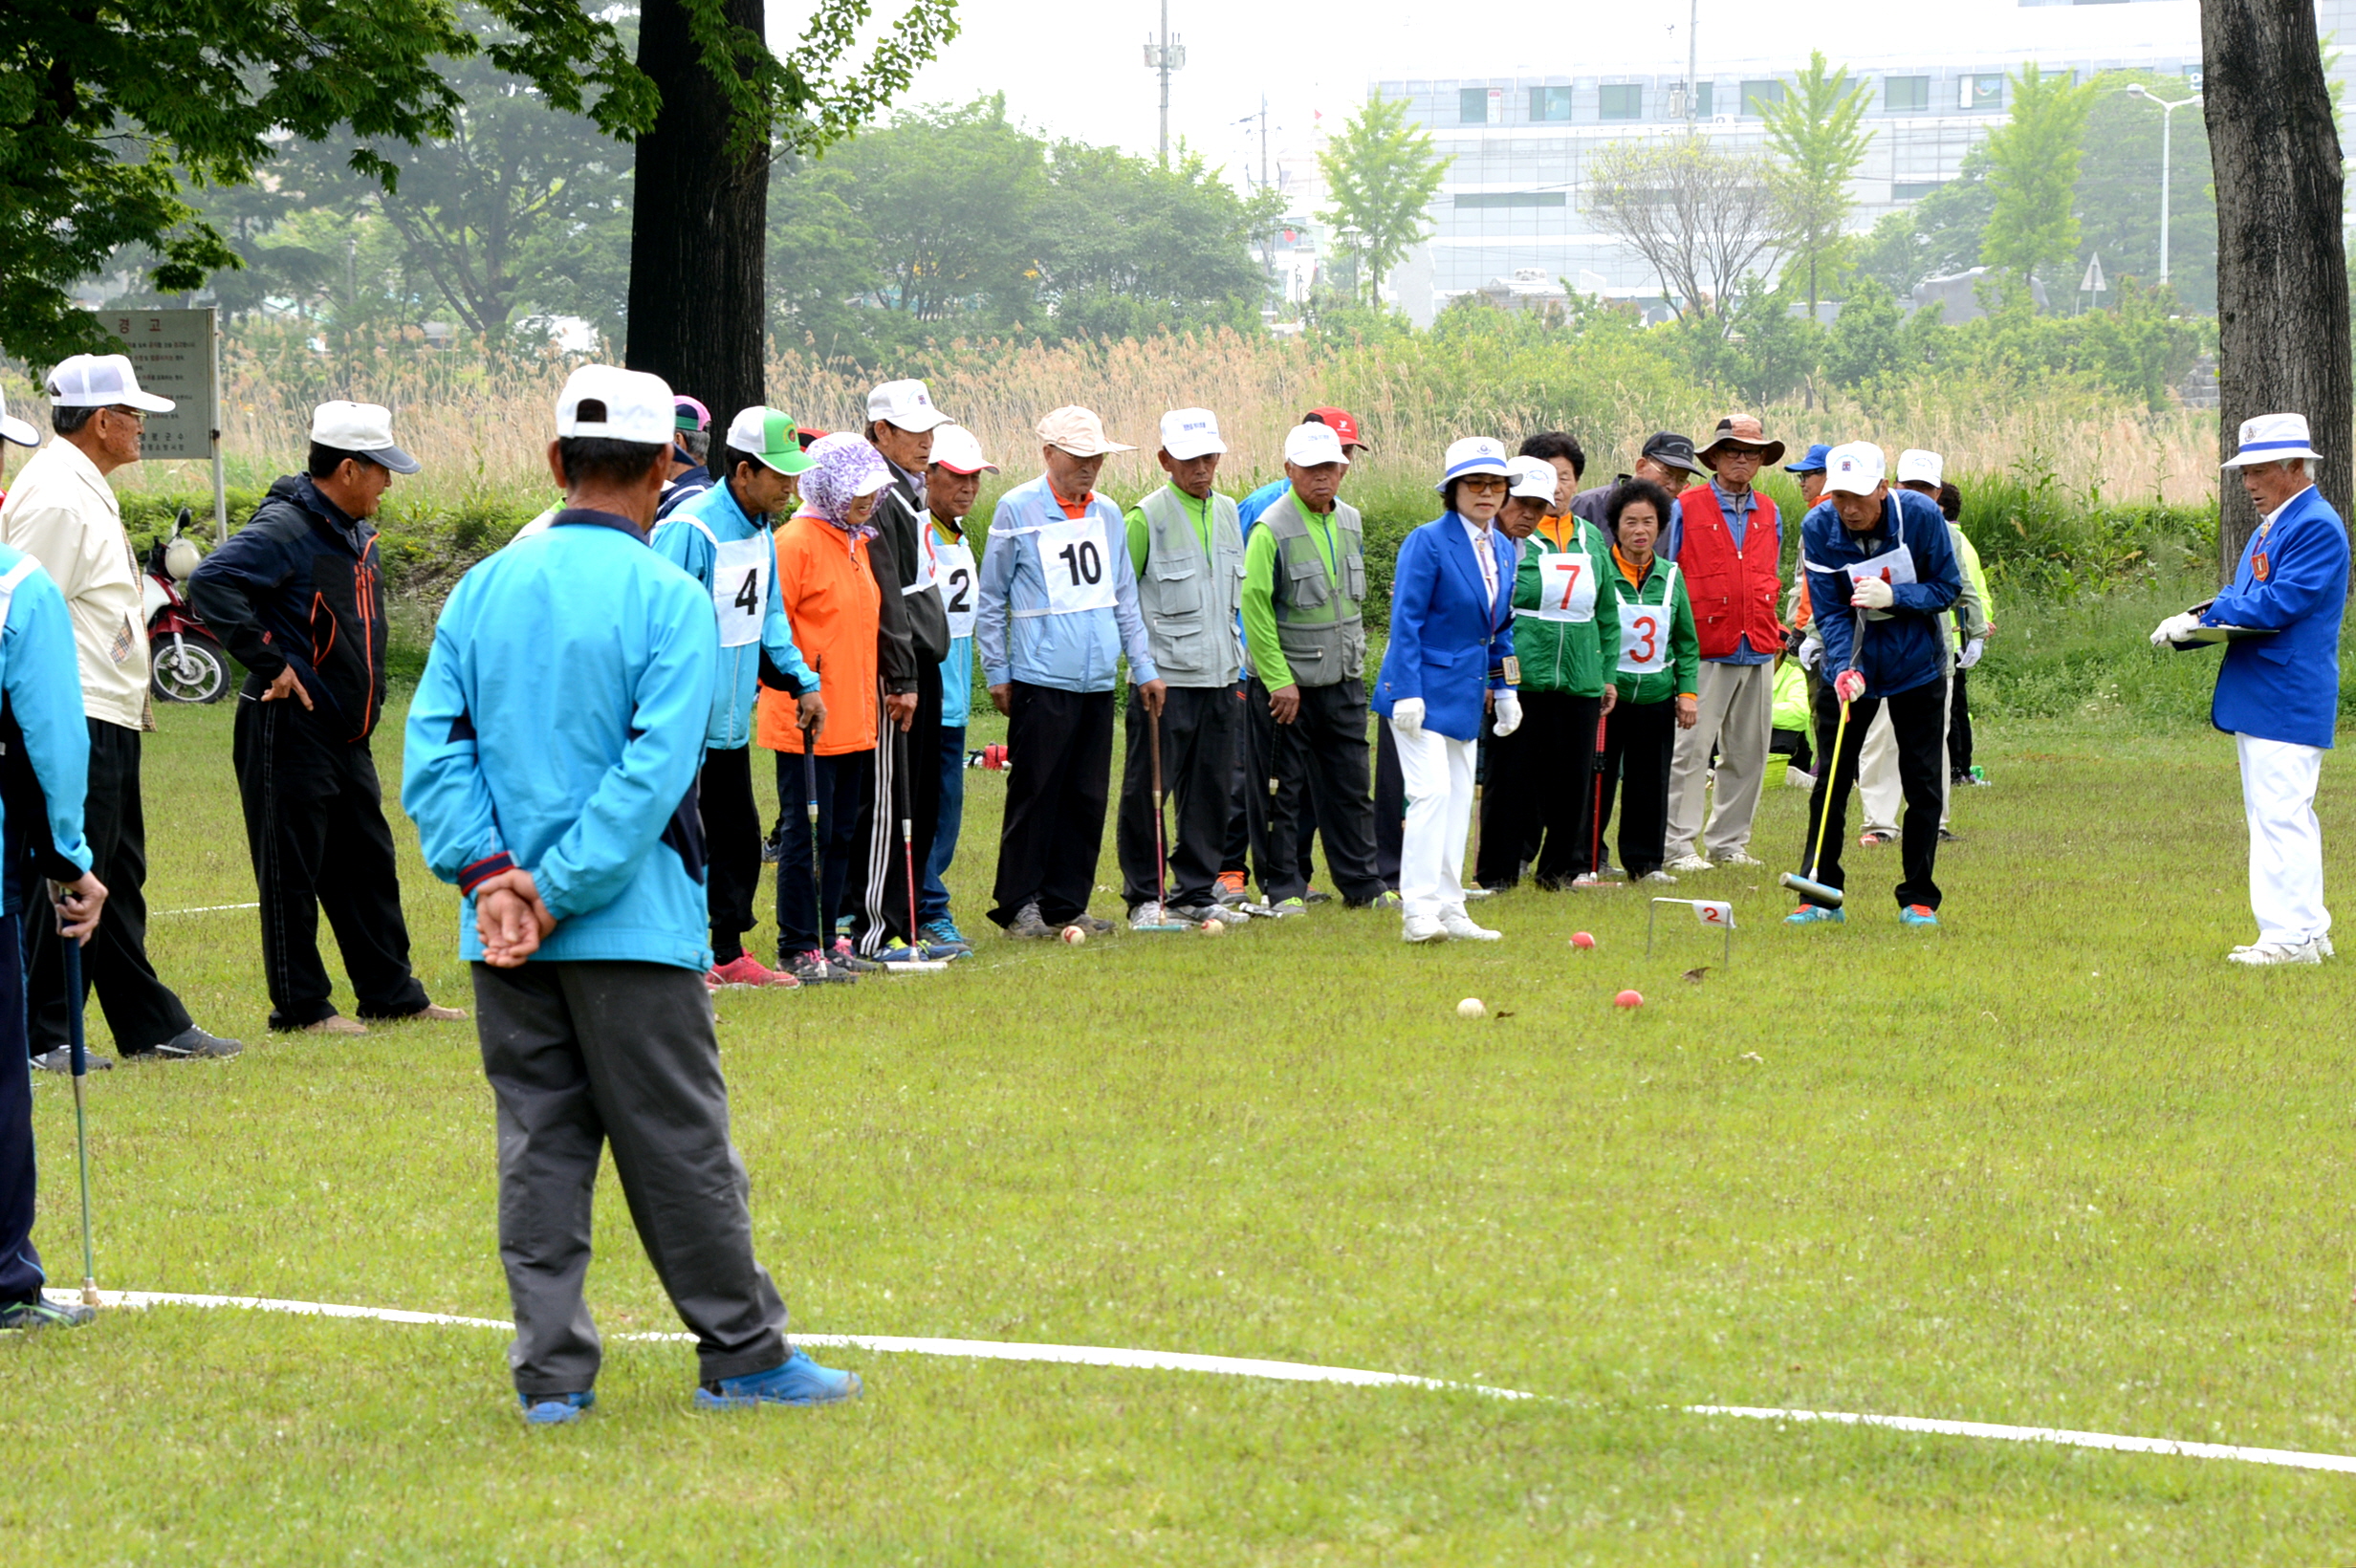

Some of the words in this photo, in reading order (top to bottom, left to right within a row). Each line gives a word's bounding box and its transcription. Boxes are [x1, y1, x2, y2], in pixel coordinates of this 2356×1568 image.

[1058, 540, 1102, 586] 10
[734, 568, 758, 616] 4
[948, 568, 971, 613] 2
[1556, 564, 1582, 610] 7
[1628, 616, 1657, 664] 3
[1703, 906, 1722, 923] 2
